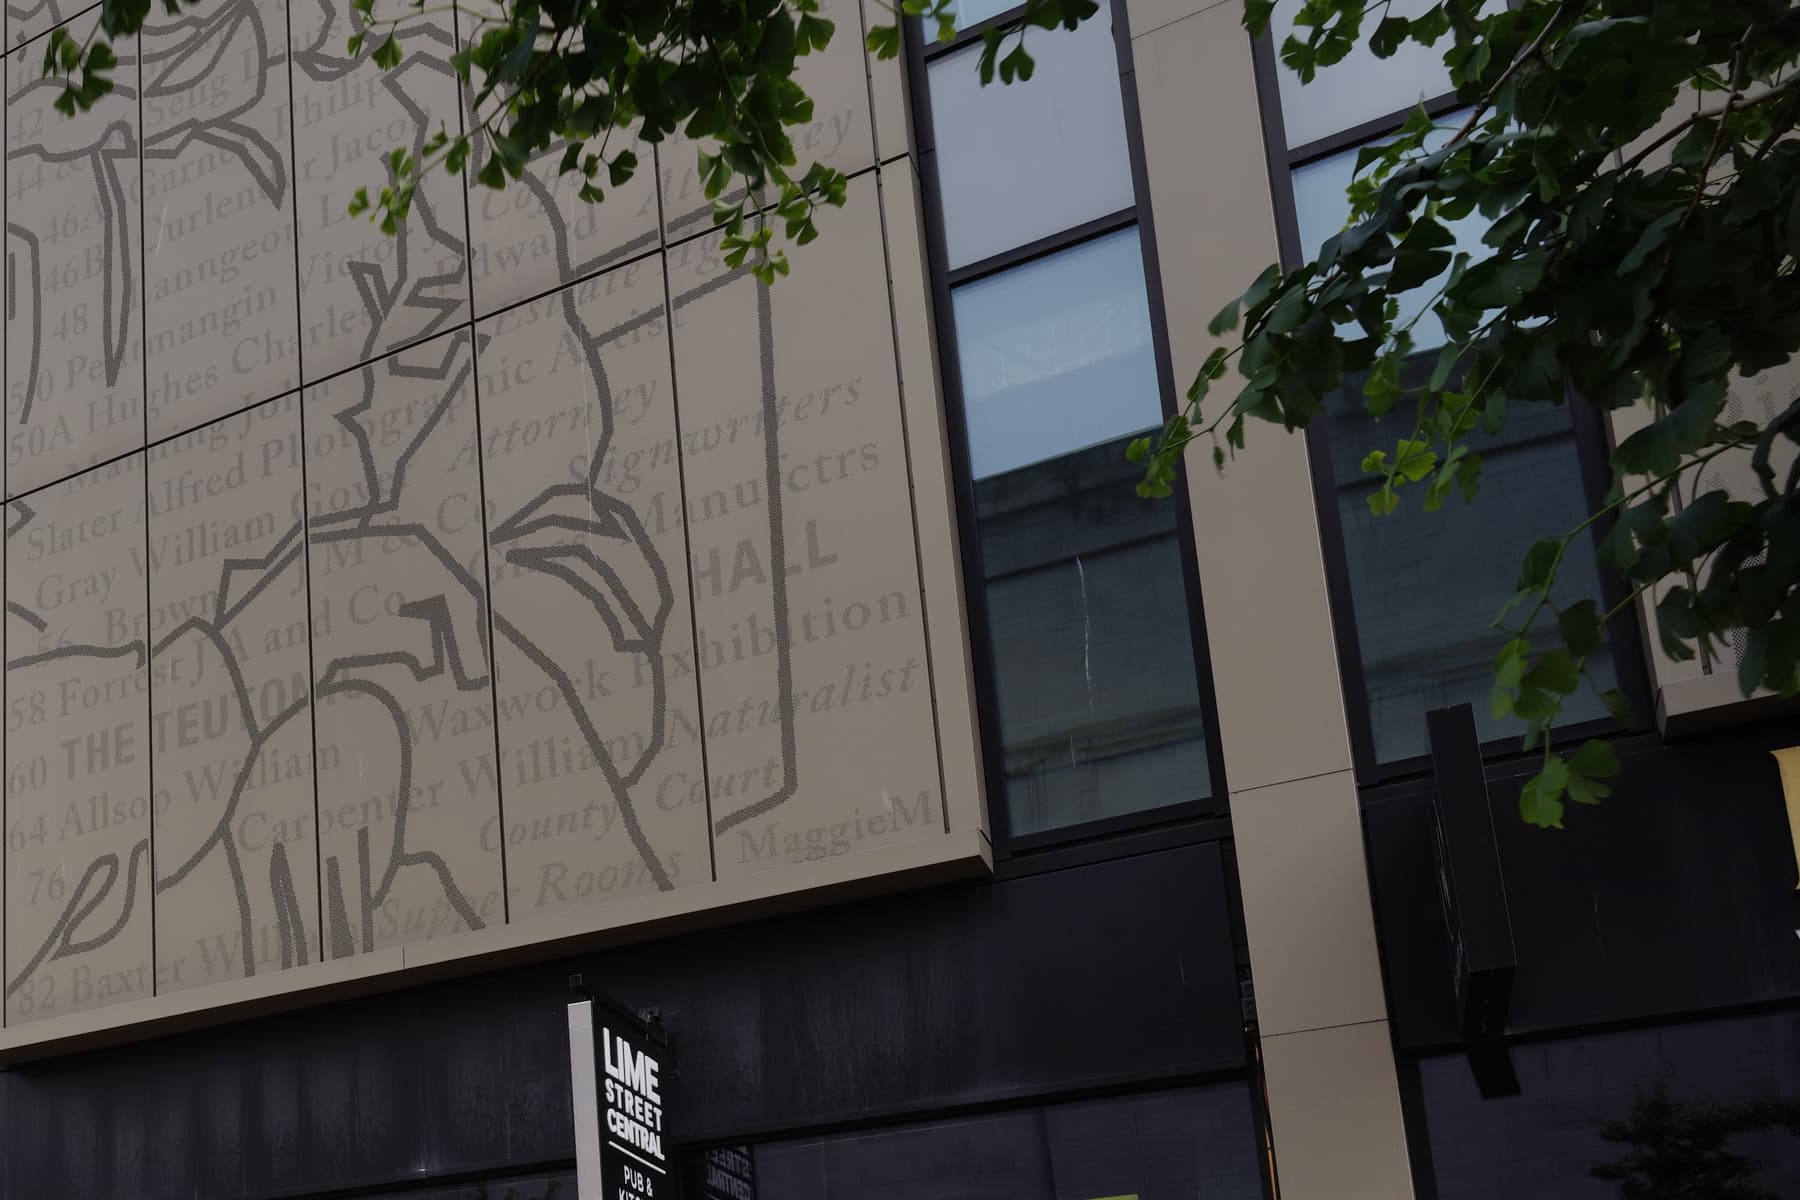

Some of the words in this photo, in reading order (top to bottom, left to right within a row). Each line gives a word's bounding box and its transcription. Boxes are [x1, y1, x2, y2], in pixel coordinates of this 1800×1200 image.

[8, 160, 42, 206] 44
[41, 191, 104, 251] 46A
[43, 242, 103, 298] 46B
[53, 301, 88, 344] 48
[8, 410, 72, 466] 50A
[87, 351, 218, 437] Hughes
[27, 493, 121, 564] Slater
[131, 446, 245, 527] Alfred
[36, 550, 118, 616] Gray
[130, 495, 276, 582] William
[104, 573, 217, 648] Brown
[8, 687, 47, 733] 58
[57, 643, 183, 720] Forrest
[263, 599, 333, 656] and
[346, 574, 404, 632] Co
[8, 754, 47, 798] 60
[60, 720, 134, 782] THE
[9, 809, 47, 854] 64
[57, 772, 171, 843] Allsop
[28, 863, 65, 909] 76
[457, 710, 658, 802] William
[479, 787, 618, 855] County
[655, 748, 781, 814] Court
[18, 971, 56, 1018] 82
[71, 943, 185, 1005] Baxter
[603, 1026, 662, 1105] LIME
[605, 1082, 663, 1128] STREET
[606, 1107, 666, 1161] CENTRAL
[623, 1164, 644, 1192] PUB
[644, 1175, 654, 1196] &
